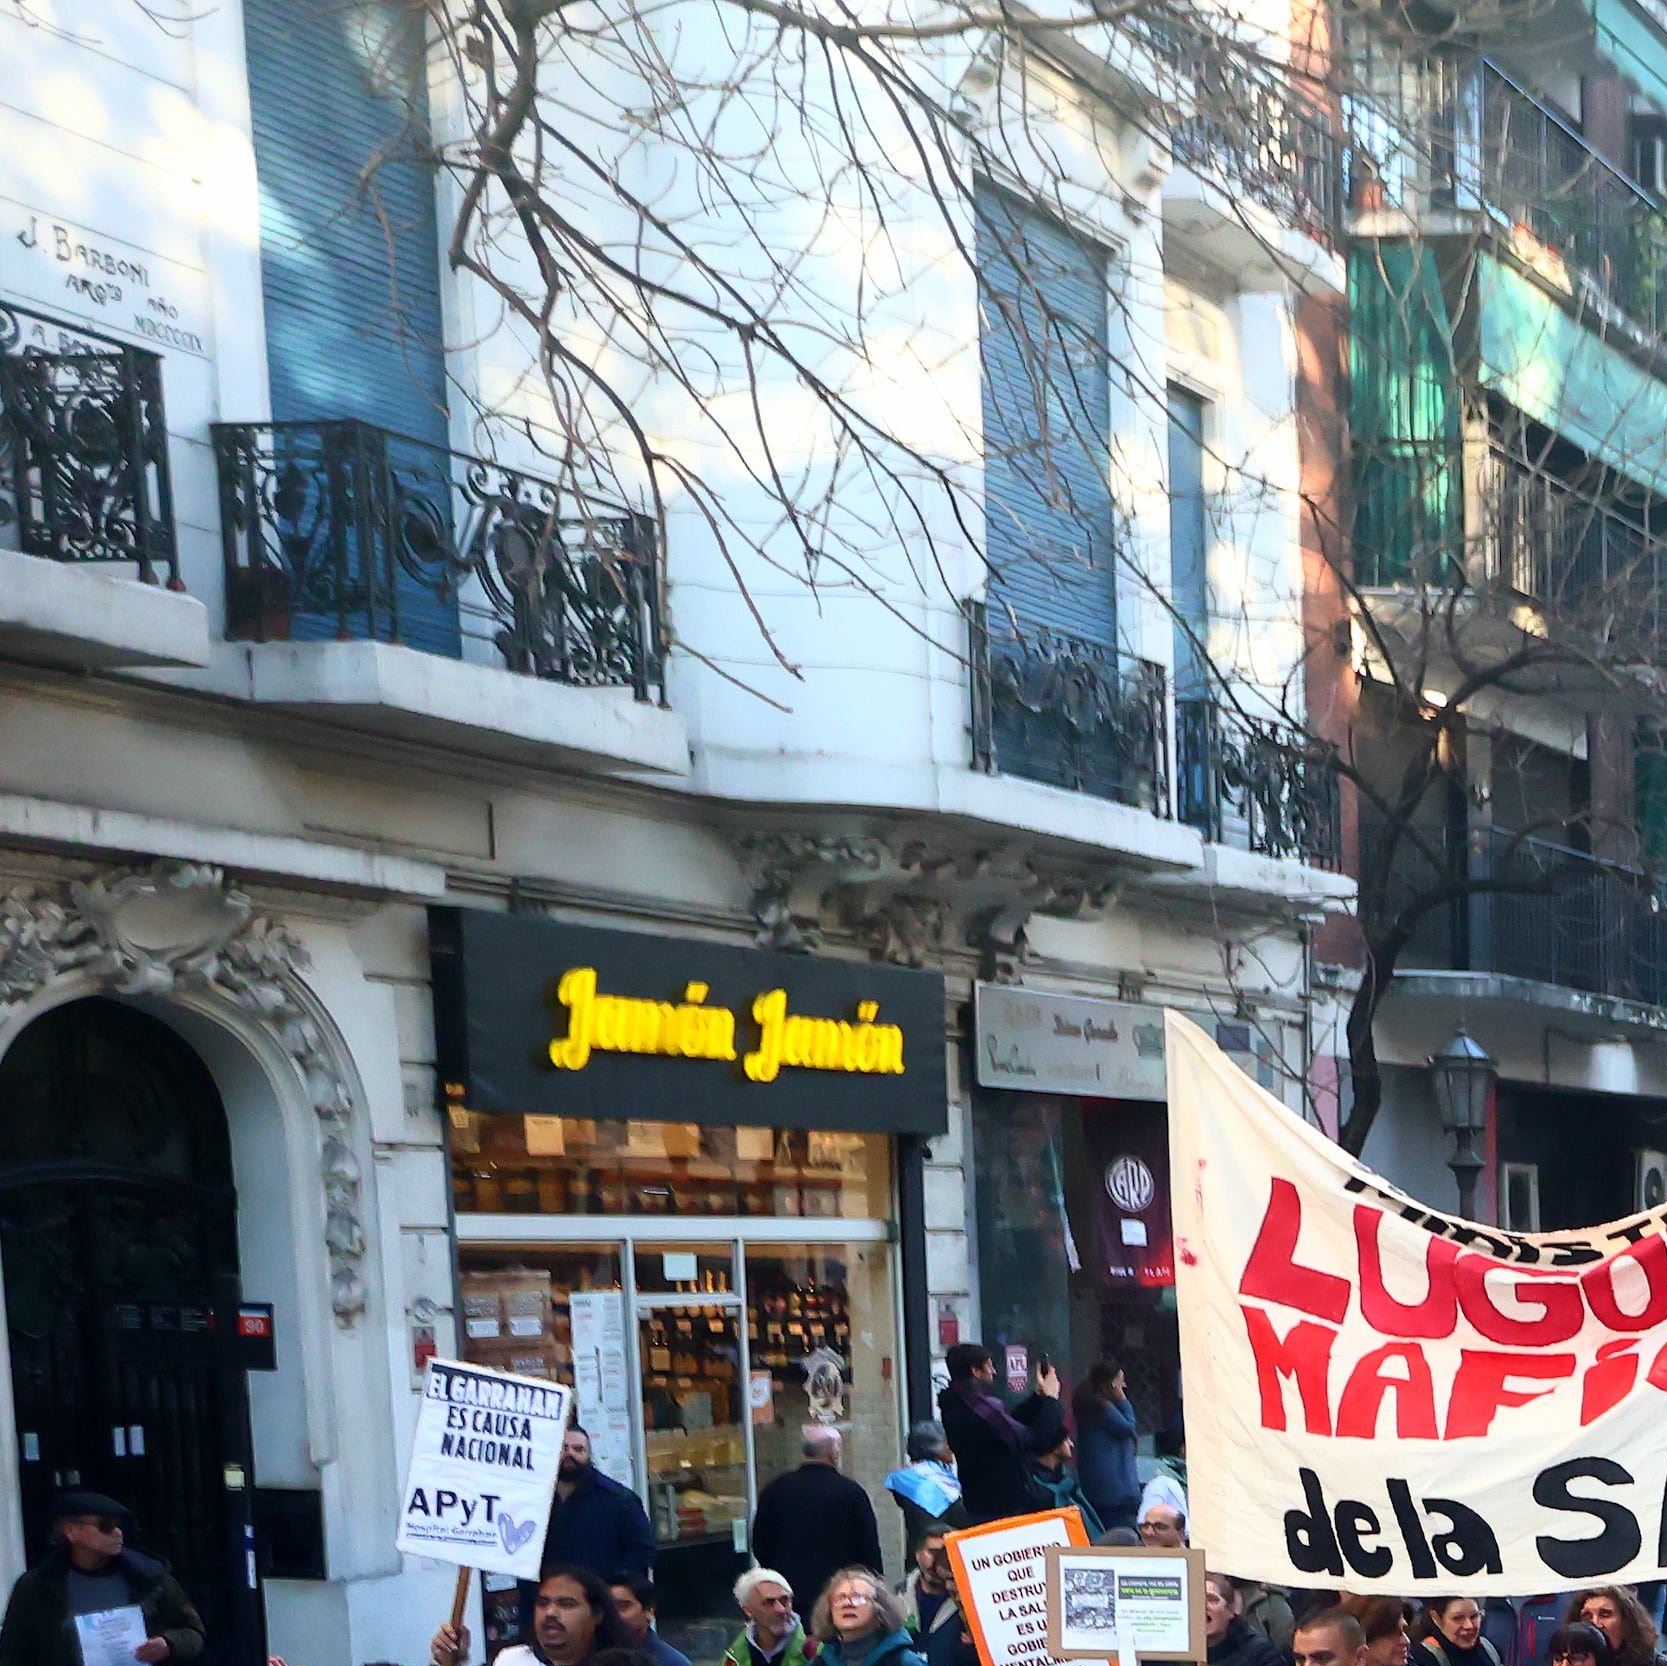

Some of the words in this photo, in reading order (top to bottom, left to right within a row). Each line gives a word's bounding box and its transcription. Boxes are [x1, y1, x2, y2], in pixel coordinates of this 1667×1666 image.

[53, 225, 151, 288] BARBONI
[549, 967, 737, 1071] Jamón
[744, 988, 905, 1083] Jamón
[427, 1372, 448, 1400] EL
[450, 1376, 562, 1418] GARRAHAN
[447, 1405, 466, 1429] ES
[472, 1410, 532, 1441] CAUSA
[441, 1433, 535, 1471] NACIONAL
[408, 1488, 500, 1526] APyT
[971, 1557, 990, 1571] UN
[1007, 1566, 1035, 1581] QUE
[999, 1608, 1016, 1621] LA
[1016, 1624, 1035, 1637] ES
